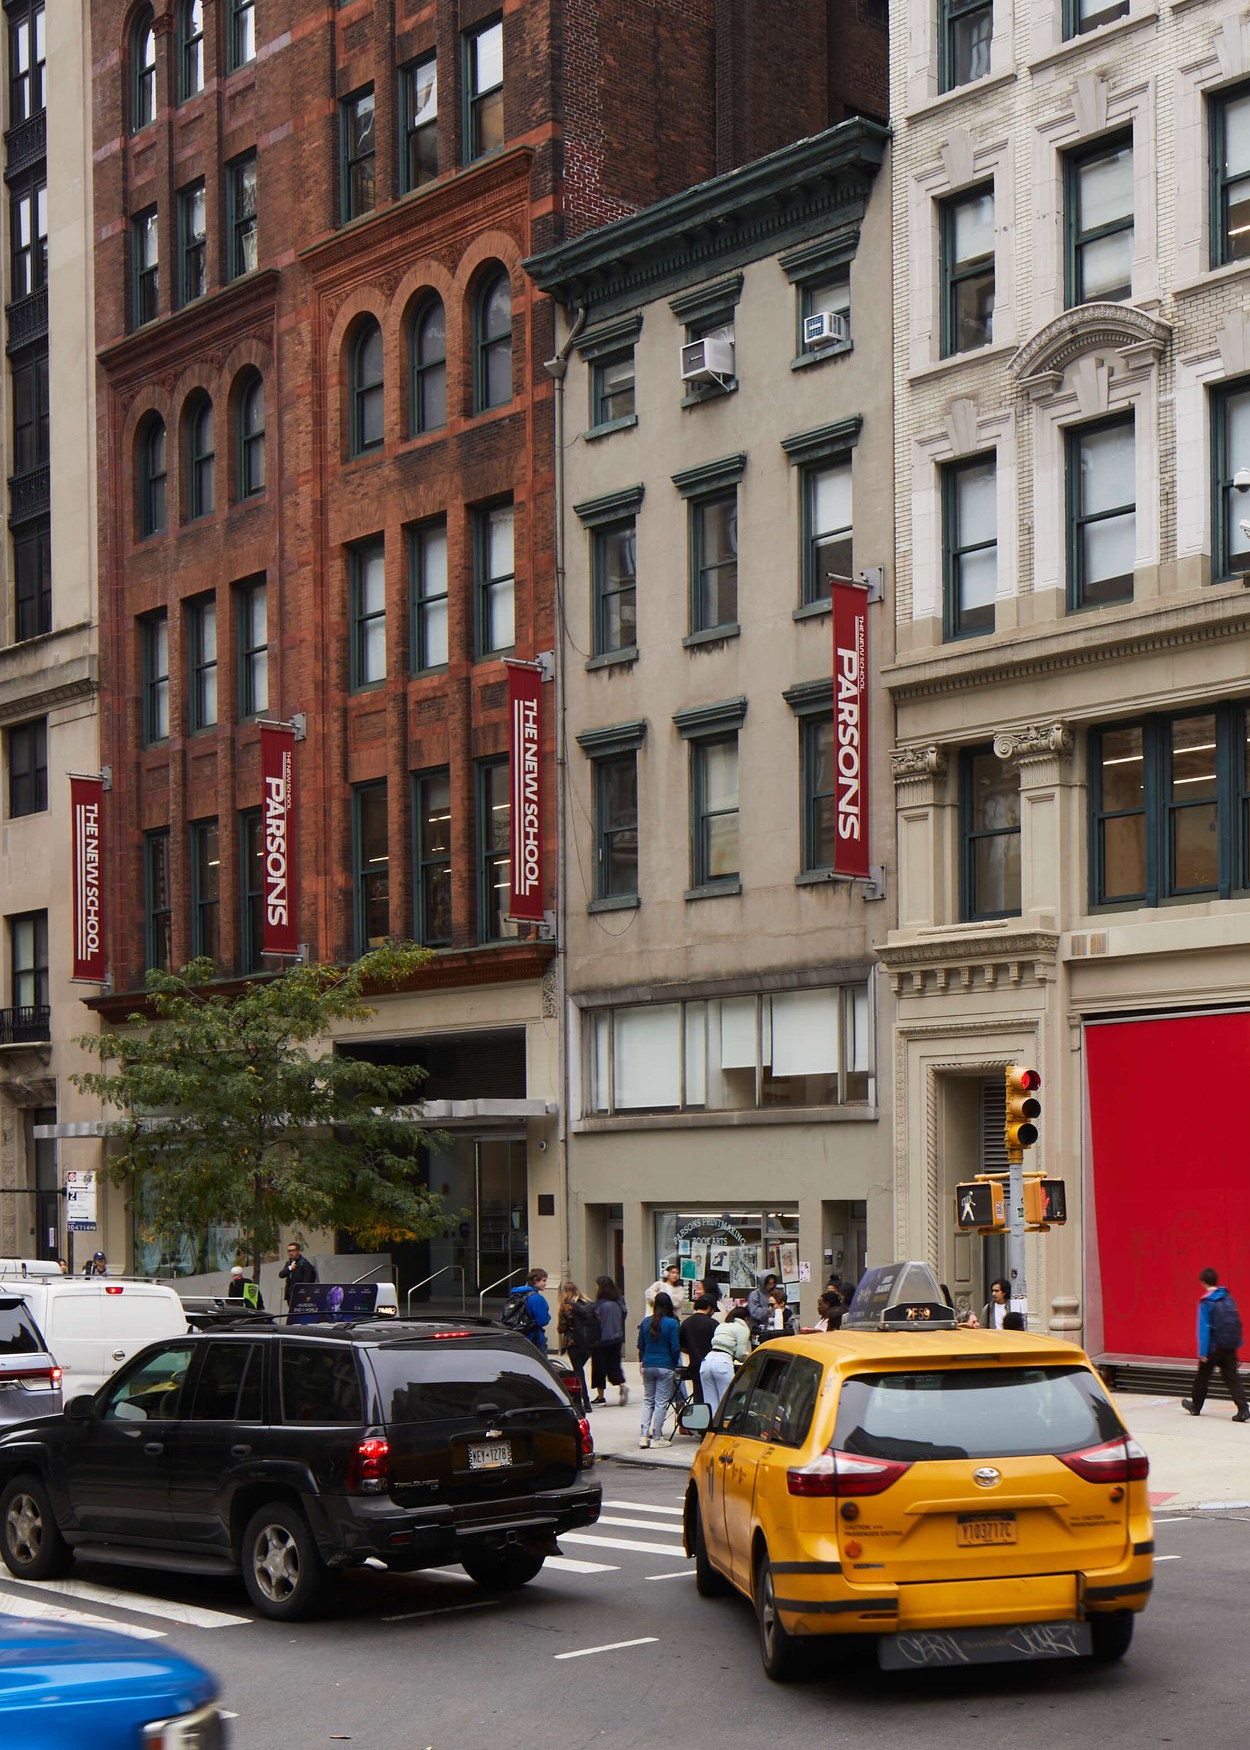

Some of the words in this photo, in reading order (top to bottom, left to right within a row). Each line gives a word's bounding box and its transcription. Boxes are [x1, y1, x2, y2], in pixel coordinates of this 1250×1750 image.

[524, 698, 538, 741] THE
[837, 647, 859, 840] PARSONS
[525, 743, 539, 802] NEW
[85, 803, 98, 837] THE
[86, 839, 98, 886] NEW
[265, 776, 287, 926] PARSONS
[525, 804, 539, 896] SCHOOL
[86, 887, 99, 961] SCHOOL
[673, 1218, 702, 1245] PARSONS
[702, 1217, 747, 1246] PRINTMAKING
[711, 1237, 728, 1245] ARTS
[905, 1307, 931, 1320] 2F59
